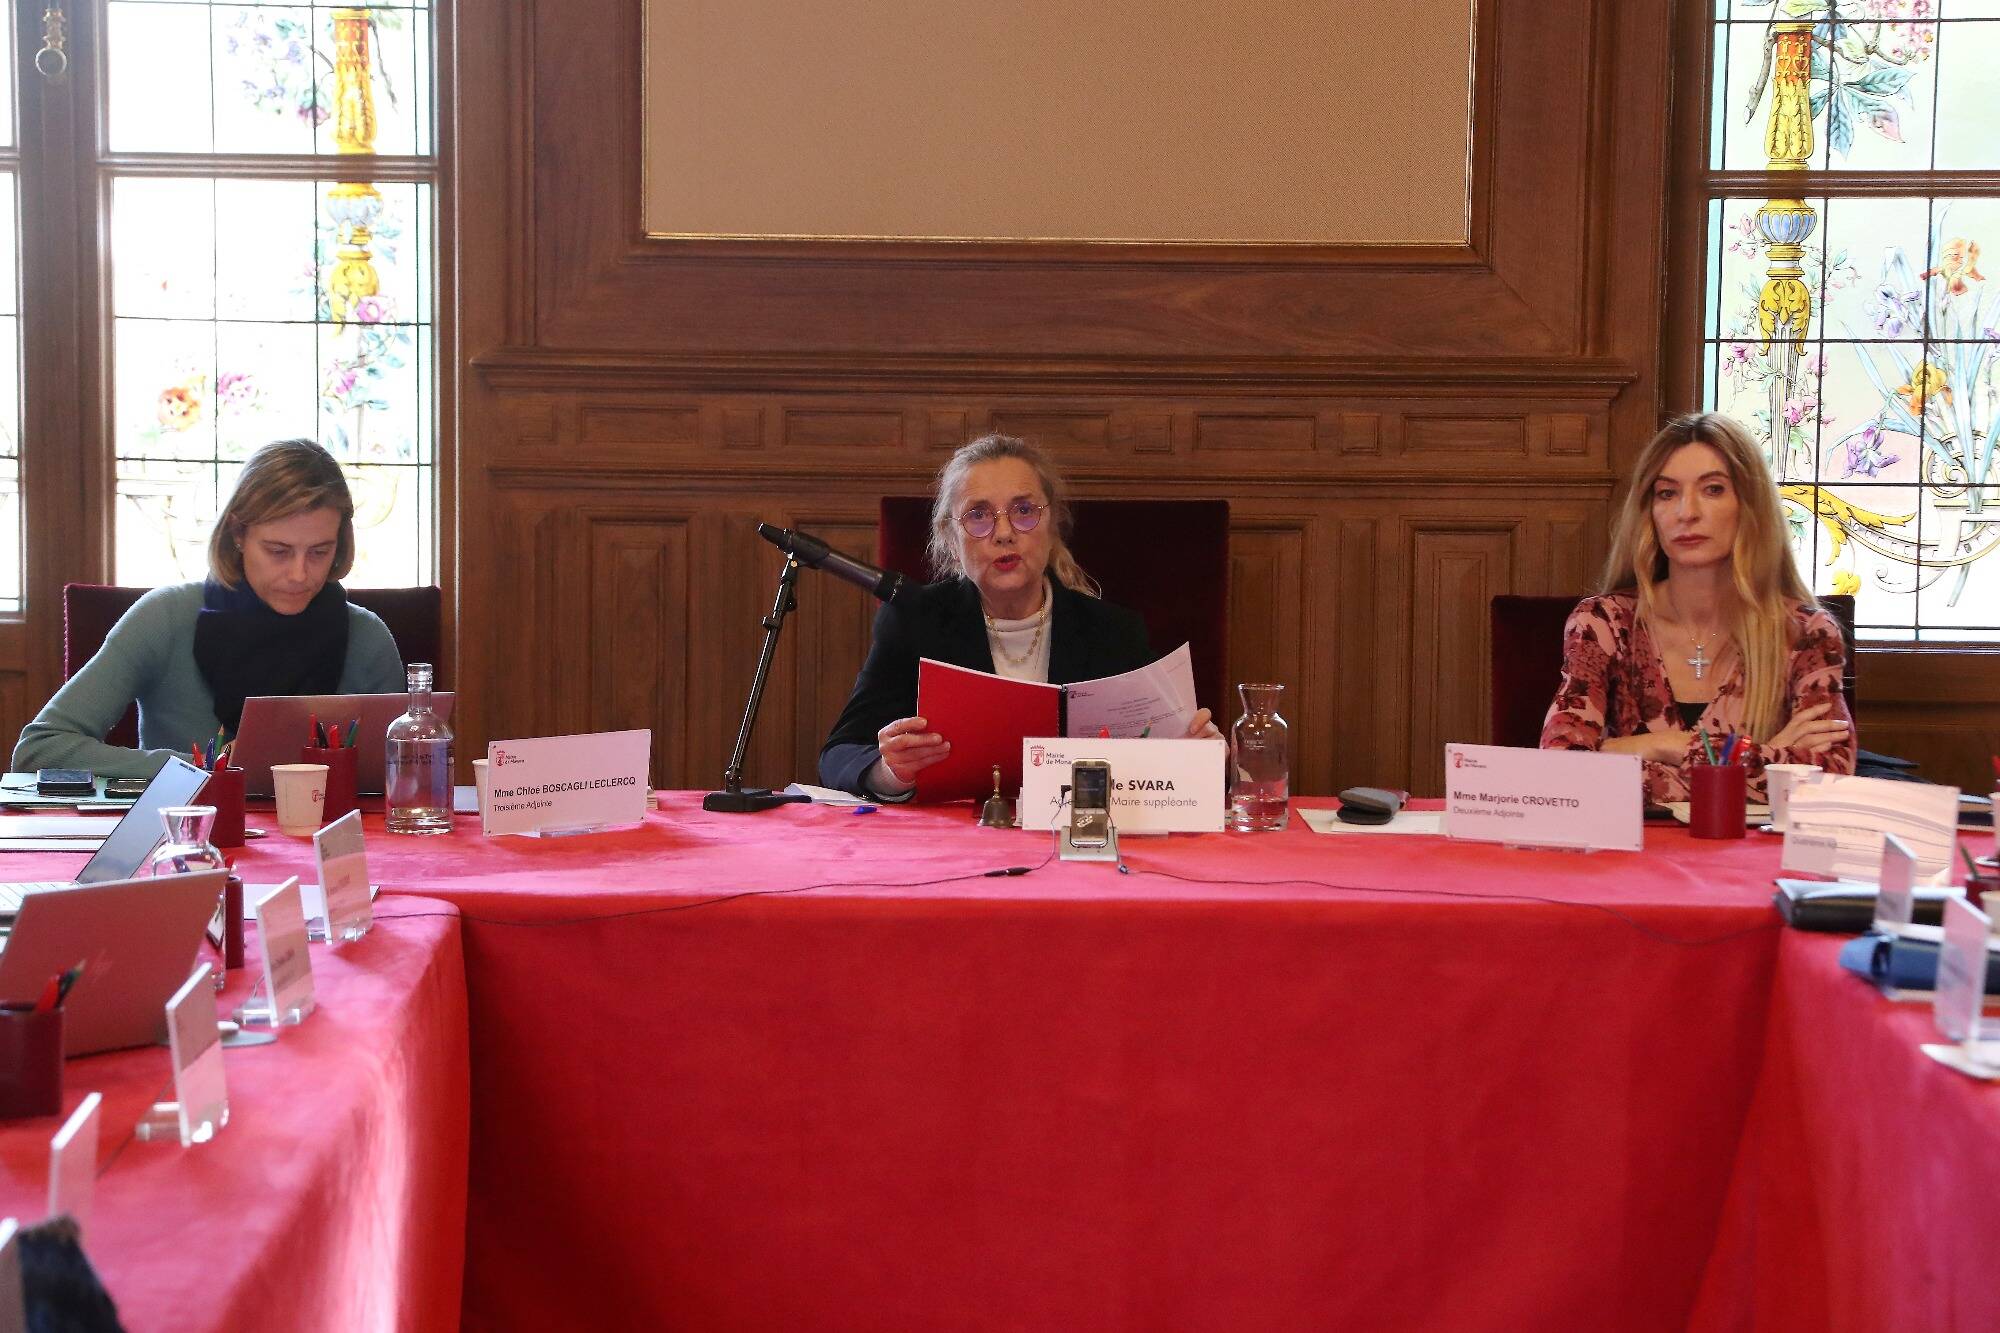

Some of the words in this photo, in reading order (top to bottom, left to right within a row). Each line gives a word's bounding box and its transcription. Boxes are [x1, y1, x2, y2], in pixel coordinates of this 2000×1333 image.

[494, 788, 514, 798] Mme
[542, 780, 588, 794] BOSCAGLI
[589, 776, 636, 789] LECLERCQ
[1128, 779, 1175, 791] SVARA
[1111, 796, 1141, 806] Maire
[1143, 796, 1199, 809] suppléante
[1453, 791, 1477, 801] Mme
[1479, 792, 1520, 805] Marjorie
[1522, 795, 1580, 808] CROVETTO
